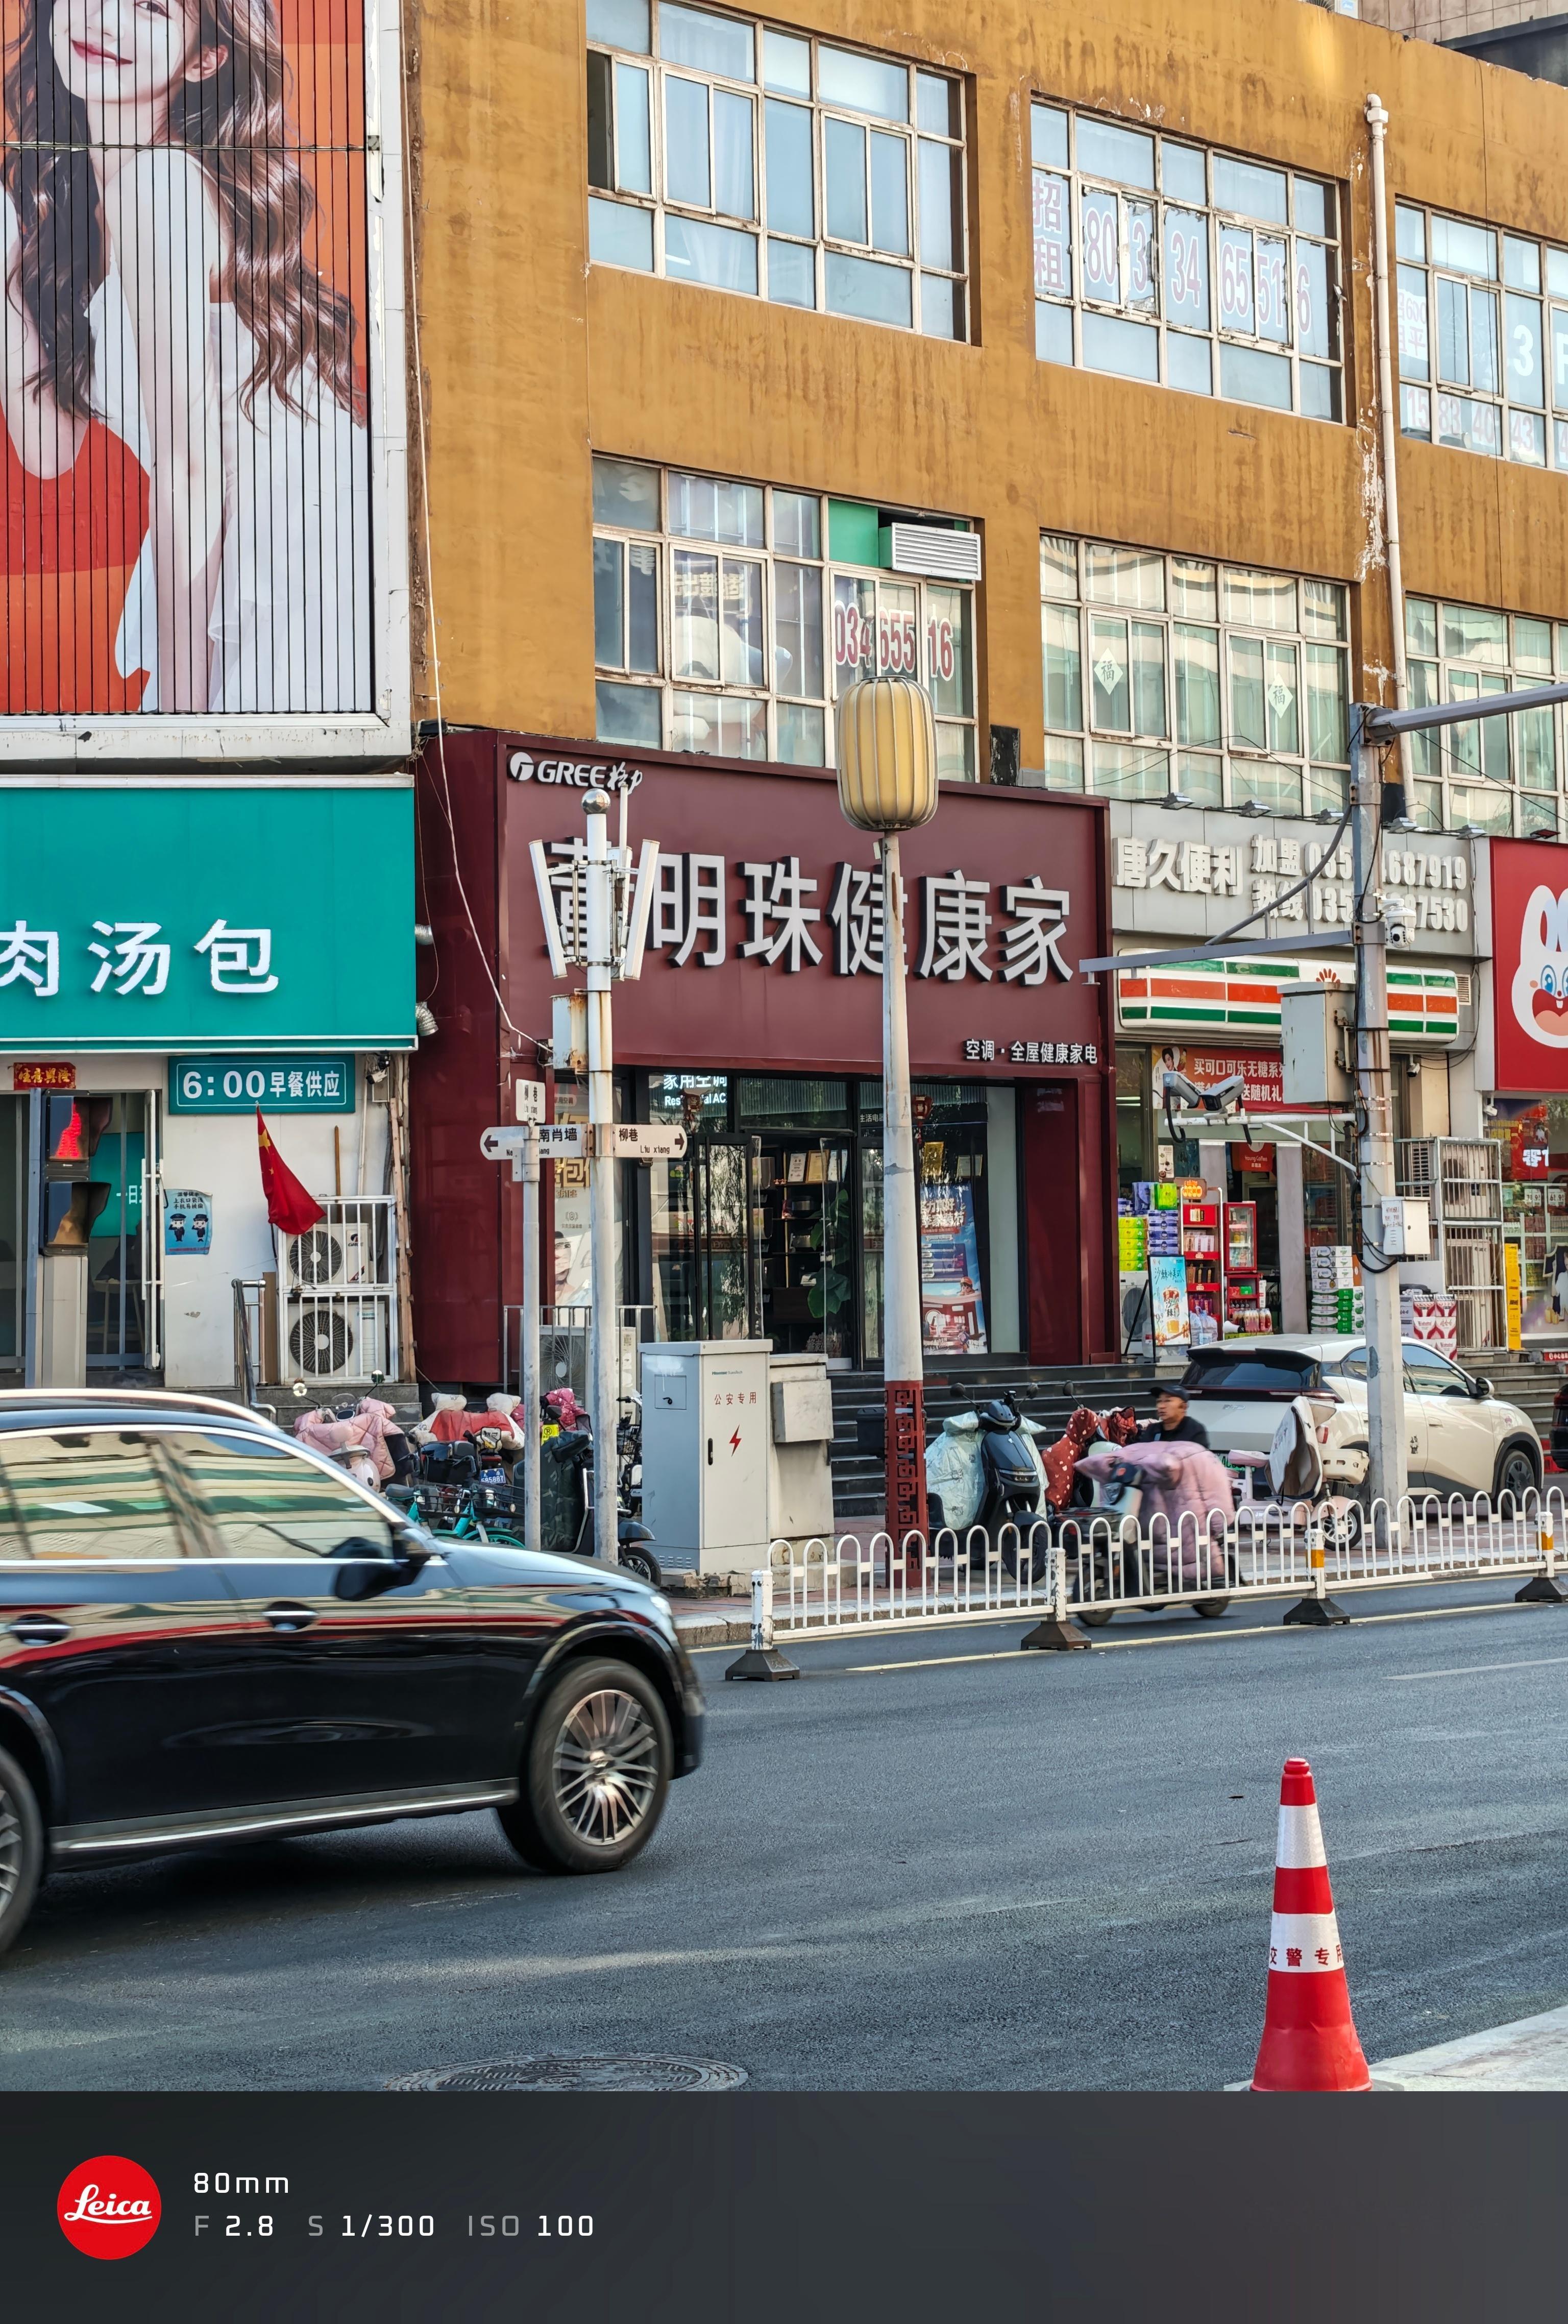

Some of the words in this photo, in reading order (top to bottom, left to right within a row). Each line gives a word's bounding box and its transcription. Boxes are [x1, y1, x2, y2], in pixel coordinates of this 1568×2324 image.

[1033, 174, 1065, 292] 招租
[1100, 660, 1115, 682] 福
[1272, 685, 1286, 706] 福
[537, 760, 607, 788] GREE
[1113, 835, 1243, 897] 唐久便利
[1252, 834, 1302, 877] 加盟
[1252, 878, 1304, 921] 热线
[0, 919, 279, 997] 肉汤包
[183, 1071, 265, 1099] 6:00
[270, 1070, 340, 1098] 早餐供应
[1240, 1084, 1284, 1102] 送随机礼
[714, 1094, 726, 1104] AC
[538, 1127, 577, 1143] 南肖墙
[619, 1128, 638, 1142] 柳巷
[640, 1145, 650, 1154] Liu
[653, 1145, 670, 1154] xiang
[715, 1392, 757, 1406] 公安专用
